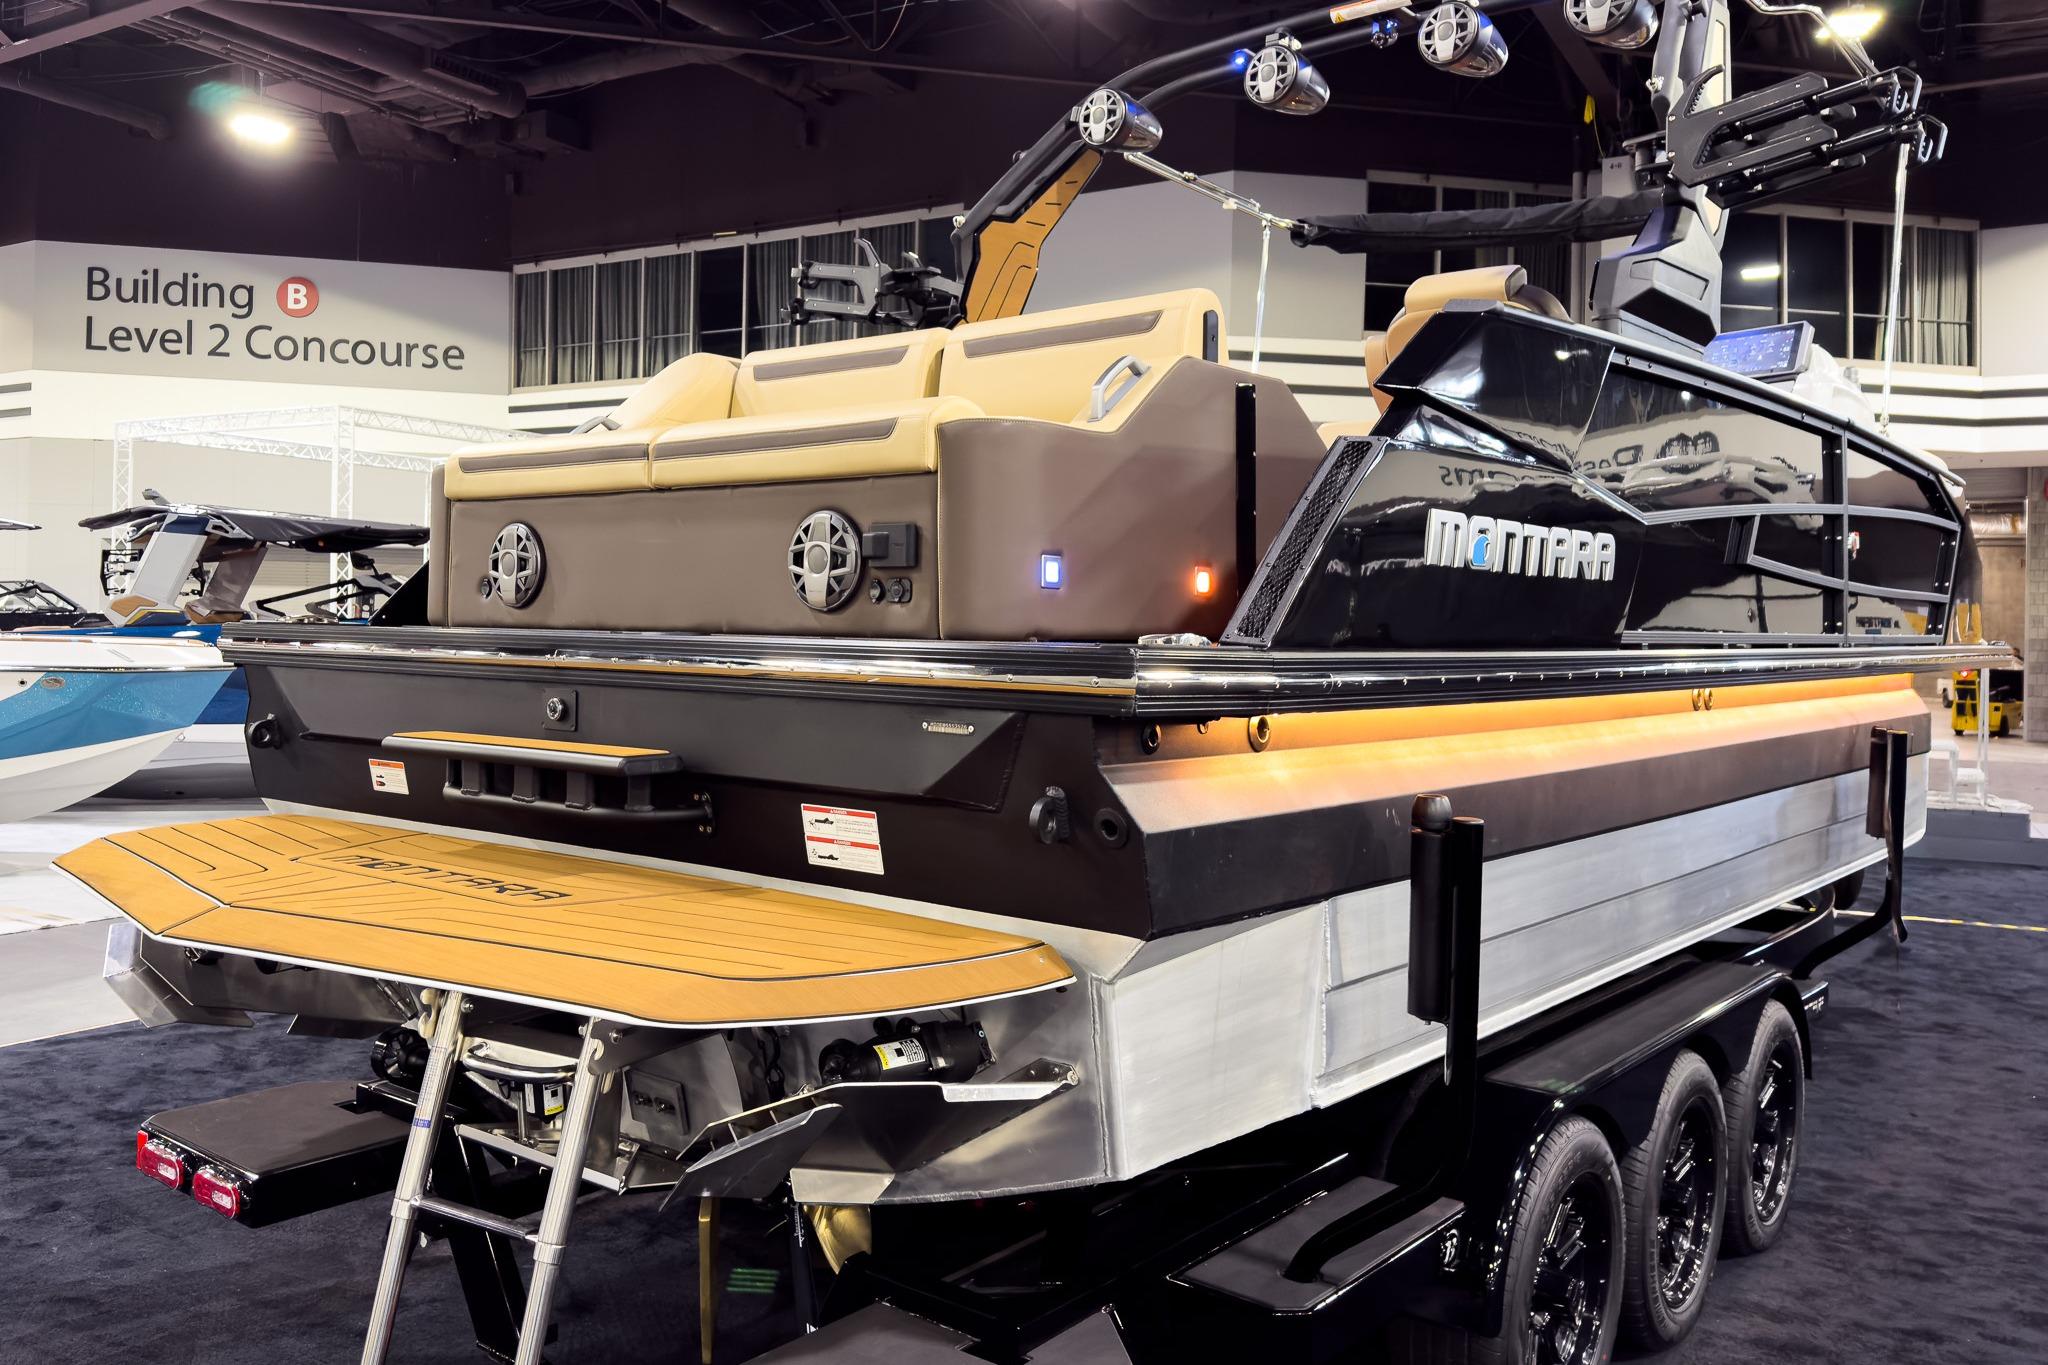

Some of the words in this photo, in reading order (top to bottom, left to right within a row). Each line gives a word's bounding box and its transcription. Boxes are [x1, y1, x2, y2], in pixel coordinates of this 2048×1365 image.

[86, 266, 255, 319] Building
[286, 283, 310, 310] B
[85, 315, 194, 355] Level
[207, 323, 231, 358] 2
[245, 324, 466, 371] Concourse
[1424, 508, 1616, 581] MONTARA
[333, 855, 573, 901] MONTARA
